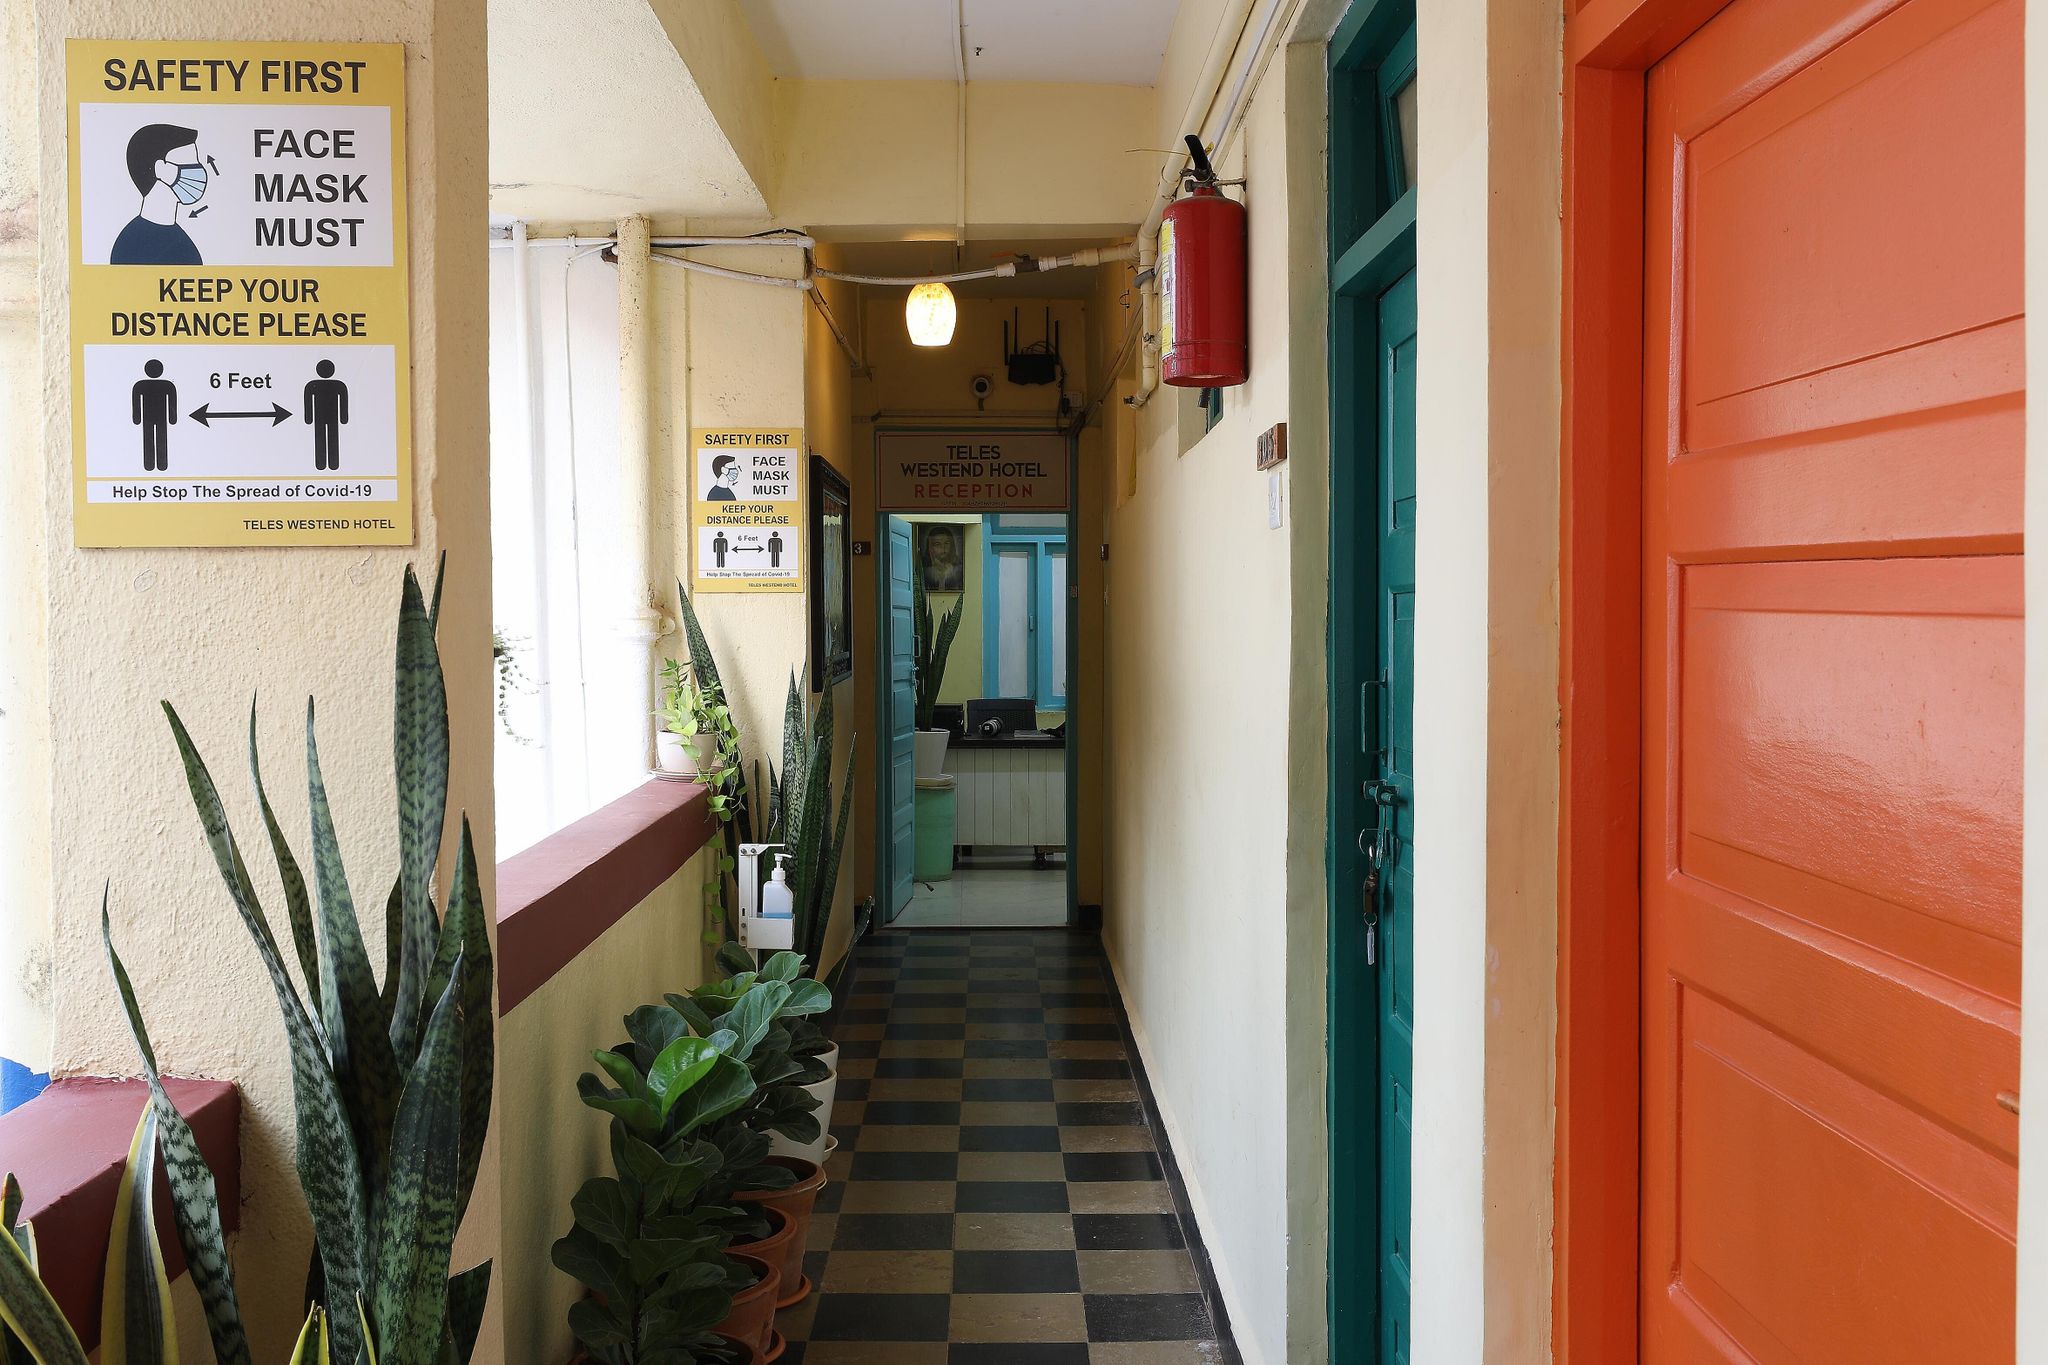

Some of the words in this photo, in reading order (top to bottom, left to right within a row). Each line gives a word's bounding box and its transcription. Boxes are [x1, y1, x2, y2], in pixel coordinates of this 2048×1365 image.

[104, 59, 249, 91] SAFETY
[262, 61, 366, 93] FIRST
[254, 130, 355, 158] FACE
[255, 174, 368, 203] MASK
[256, 218, 364, 247] MUST
[160, 279, 232, 302] KEEP
[243, 279, 319, 302] YOUR
[112, 313, 249, 336] DISTANCE
[260, 313, 366, 337] PLEASE
[210, 373, 220, 388] 6
[229, 373, 271, 388] Feet
[705, 434, 751, 445] SAFETY
[756, 435, 789, 445] FIRST
[946, 445, 1000, 460] TELES
[753, 457, 785, 466] FACE
[753, 471, 789, 480] MASK
[900, 462, 984, 477] WESTEND
[990, 463, 1047, 477] HOTEL
[113, 486, 147, 501] Help
[153, 486, 187, 500] Stop
[192, 486, 220, 497] The
[226, 485, 279, 500] Spread
[286, 485, 300, 497] of
[305, 485, 371, 496] Covid-19
[753, 485, 788, 494] MUST
[915, 484, 1032, 498] RECEPTION
[723, 505, 746, 513] KEEP
[749, 505, 773, 513] YOUR
[243, 520, 283, 529] TELES
[287, 520, 349, 529] WESTEND
[354, 520, 395, 529] HOTEL
[707, 516, 751, 524] DISTANCE
[754, 516, 789, 524] PLEASE
[855, 543, 861, 554] 3
